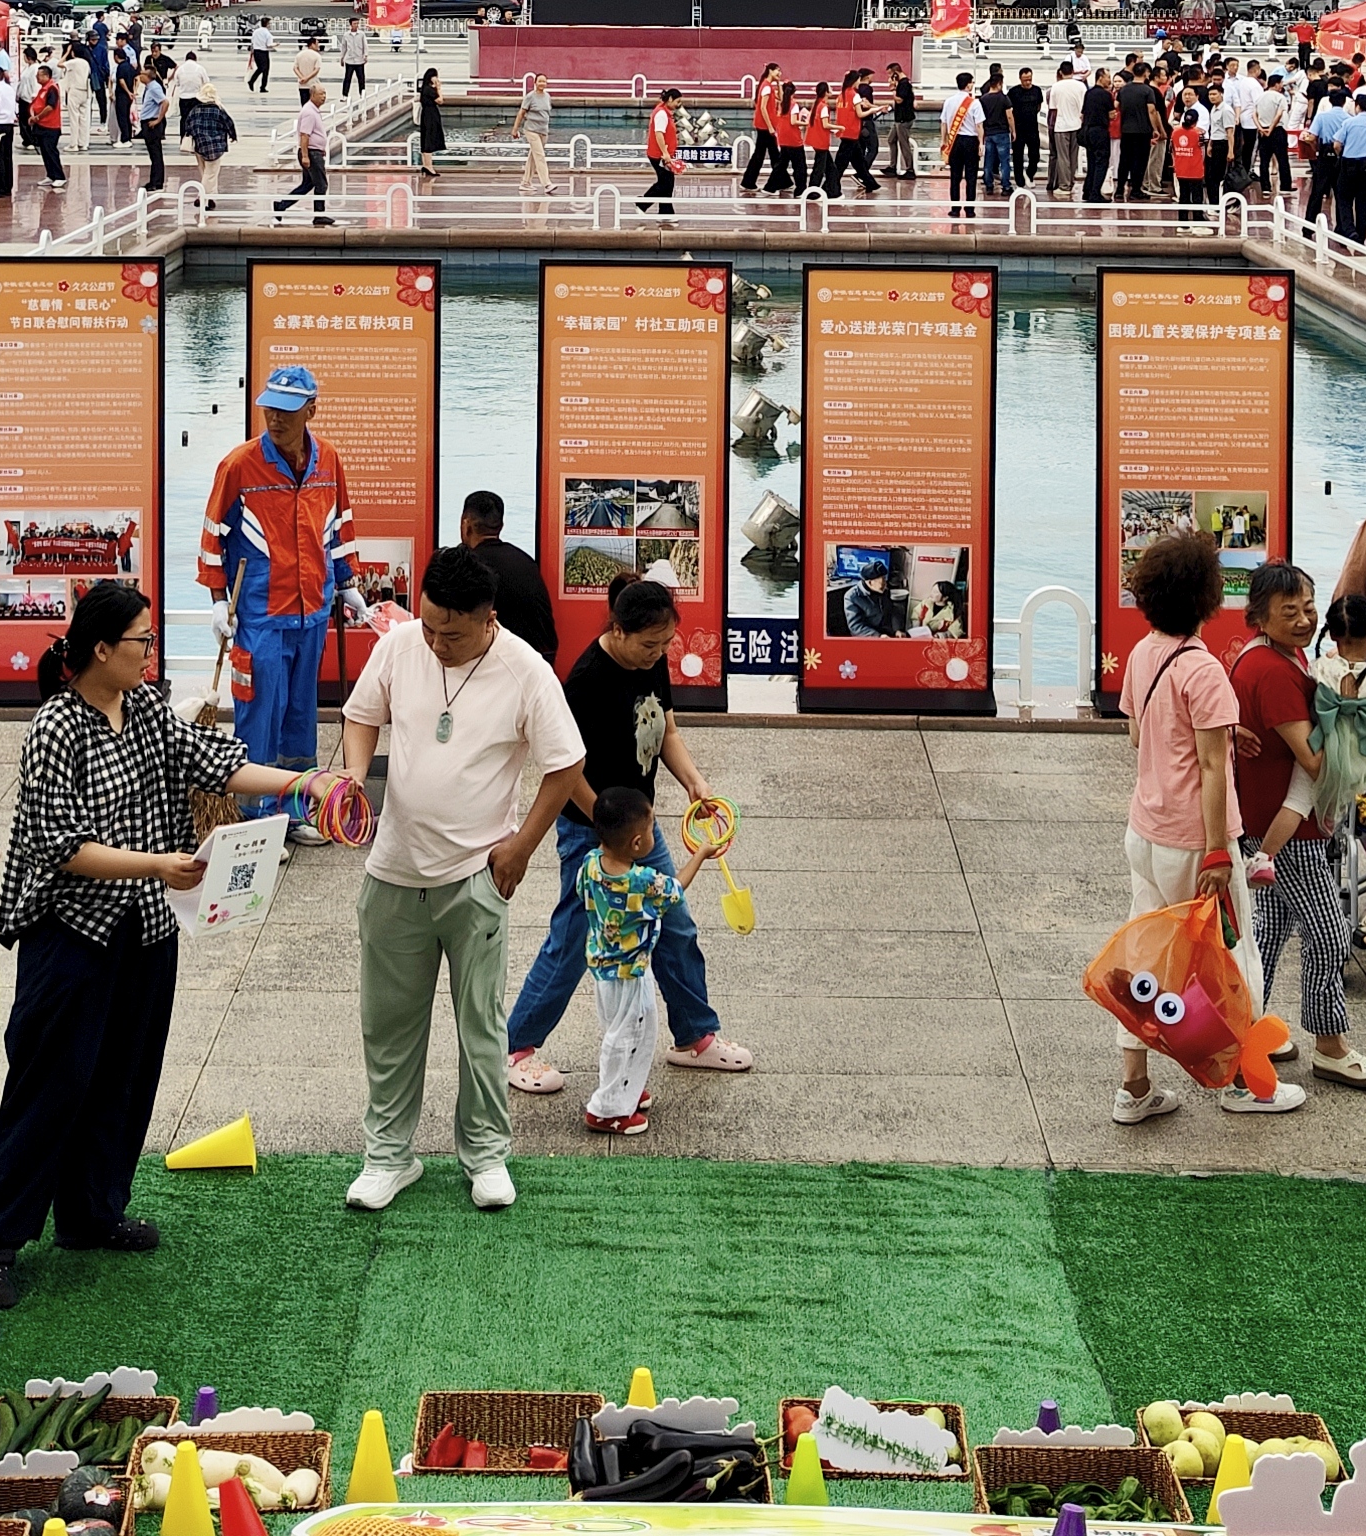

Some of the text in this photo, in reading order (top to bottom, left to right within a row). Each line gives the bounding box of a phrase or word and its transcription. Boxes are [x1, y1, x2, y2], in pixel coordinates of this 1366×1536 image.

[700, 150, 730, 161] 注意安全
[273, 314, 414, 330] 金寨革命老区帮扶项目
[820, 320, 978, 338] 爱心送进光荣门专项基金
[1108, 323, 1282, 341] 困境儿童关爱保护专项基金
[727, 628, 772, 664] 危险
